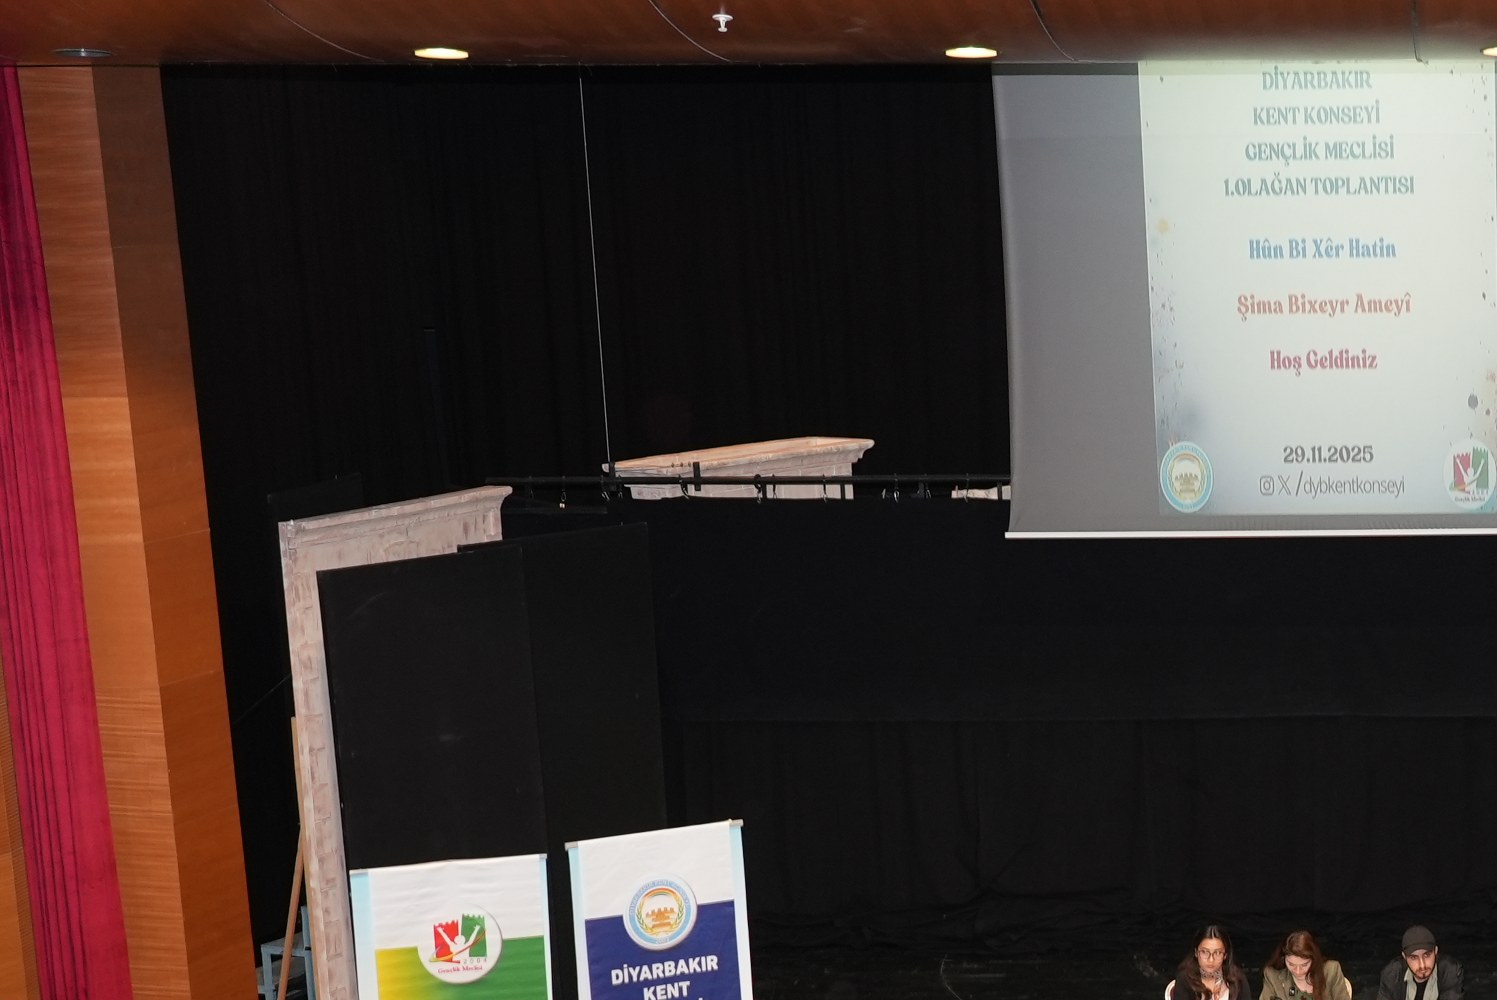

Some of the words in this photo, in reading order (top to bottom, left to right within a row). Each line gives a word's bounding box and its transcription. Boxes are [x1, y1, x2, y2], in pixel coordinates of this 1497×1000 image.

[1262, 66, 1372, 91] DİYARBAKIR
[1253, 105, 1300, 126] KENT
[1304, 99, 1381, 125] KONSEYİ
[1245, 135, 1320, 167] GENÇLİK
[1324, 134, 1395, 160] MECLİSİ
[1224, 172, 1307, 197] 1.OLAĞAN
[1311, 175, 1415, 196] TOPLANTISI
[1249, 238, 1284, 259] Hûn
[1289, 237, 1307, 259] Bi
[1312, 238, 1345, 259] Xêr
[1349, 237, 1397, 258] Hatin
[1237, 294, 1284, 321] Şima
[1288, 293, 1349, 318] Bixeyr
[1354, 292, 1412, 317] Ameyî
[1269, 350, 1302, 376] Hoş
[1306, 349, 1378, 370] Geldiniz
[1283, 445, 1374, 464] 29.11.2025
[1295, 470, 1405, 500] /dybkentkonseyi
[611, 954, 719, 986] DİYARBAKIR
